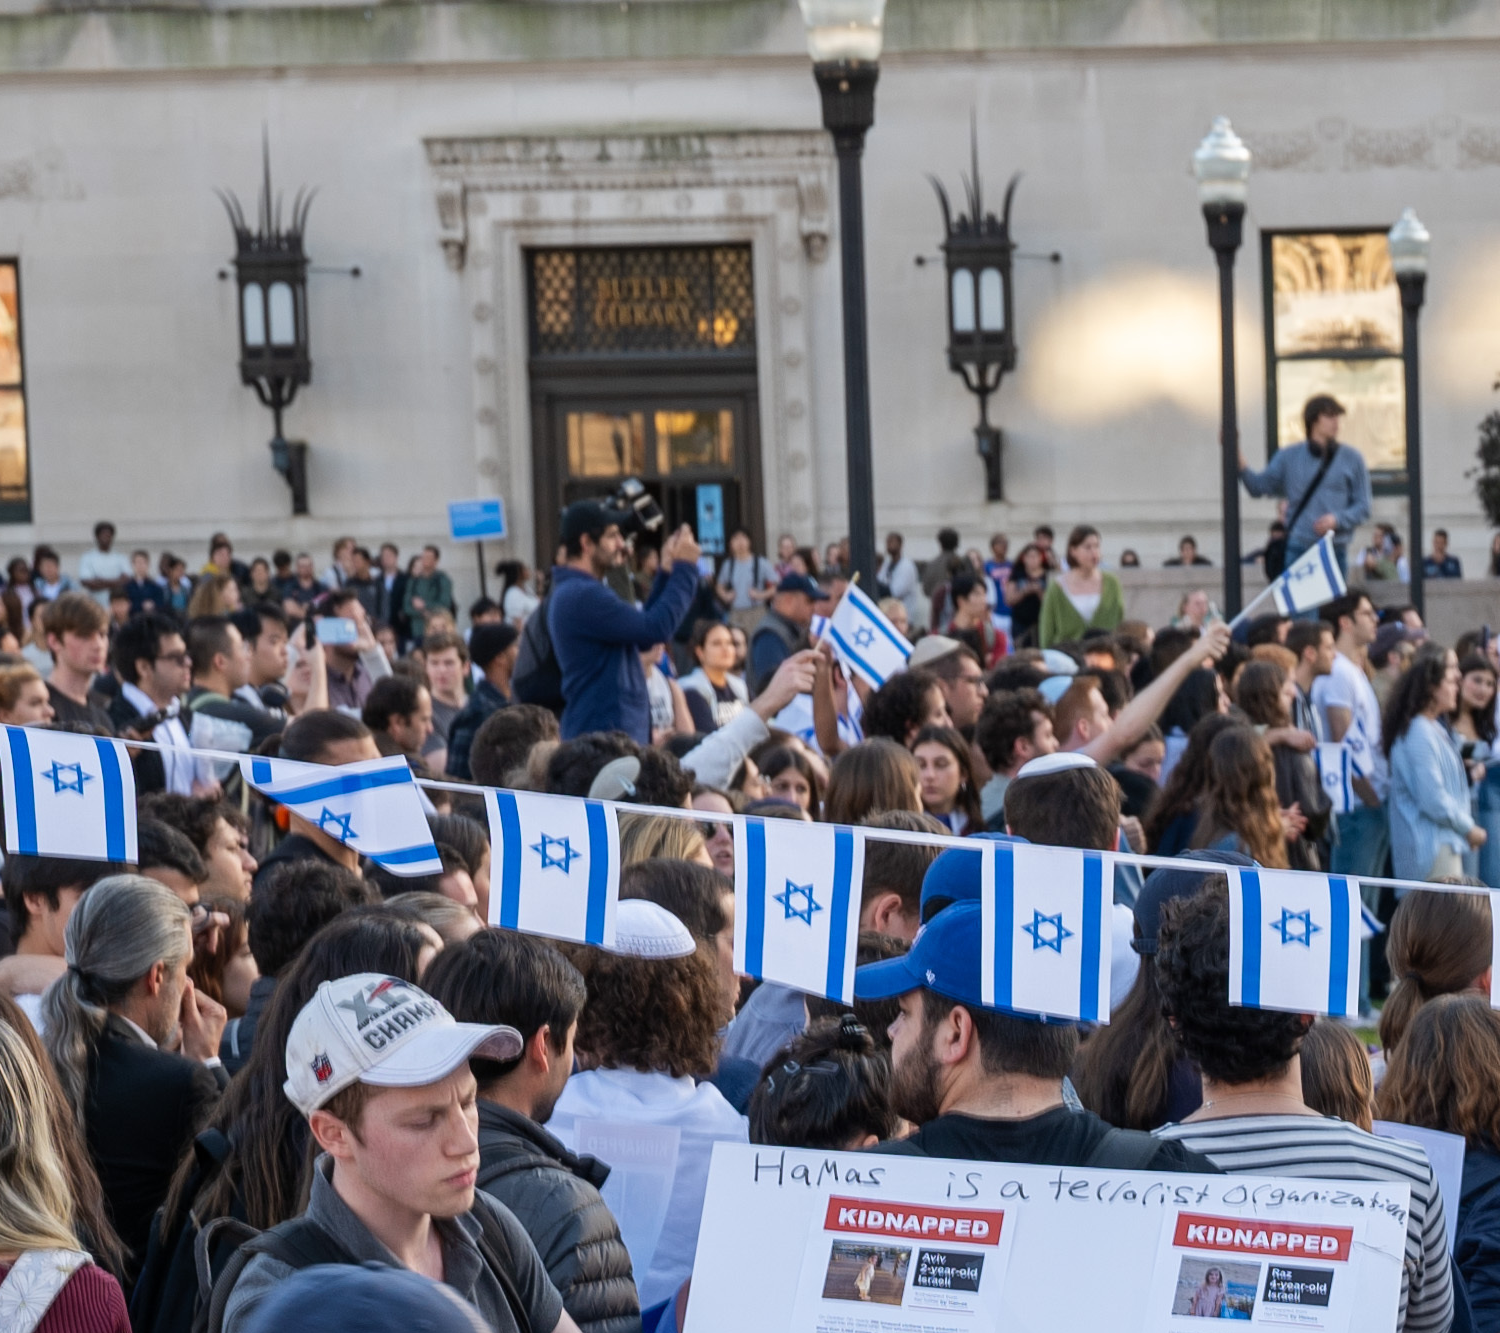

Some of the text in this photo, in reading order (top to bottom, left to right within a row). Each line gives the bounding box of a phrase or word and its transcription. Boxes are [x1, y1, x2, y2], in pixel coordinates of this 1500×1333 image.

[999, 1180, 1030, 1201] a
[1049, 1169, 1210, 1206] terrorist
[838, 1207, 990, 1238] KIDNAPPED
[1187, 1224, 1338, 1254] KIDNAPPED
[1272, 1268, 1292, 1280] Raz
